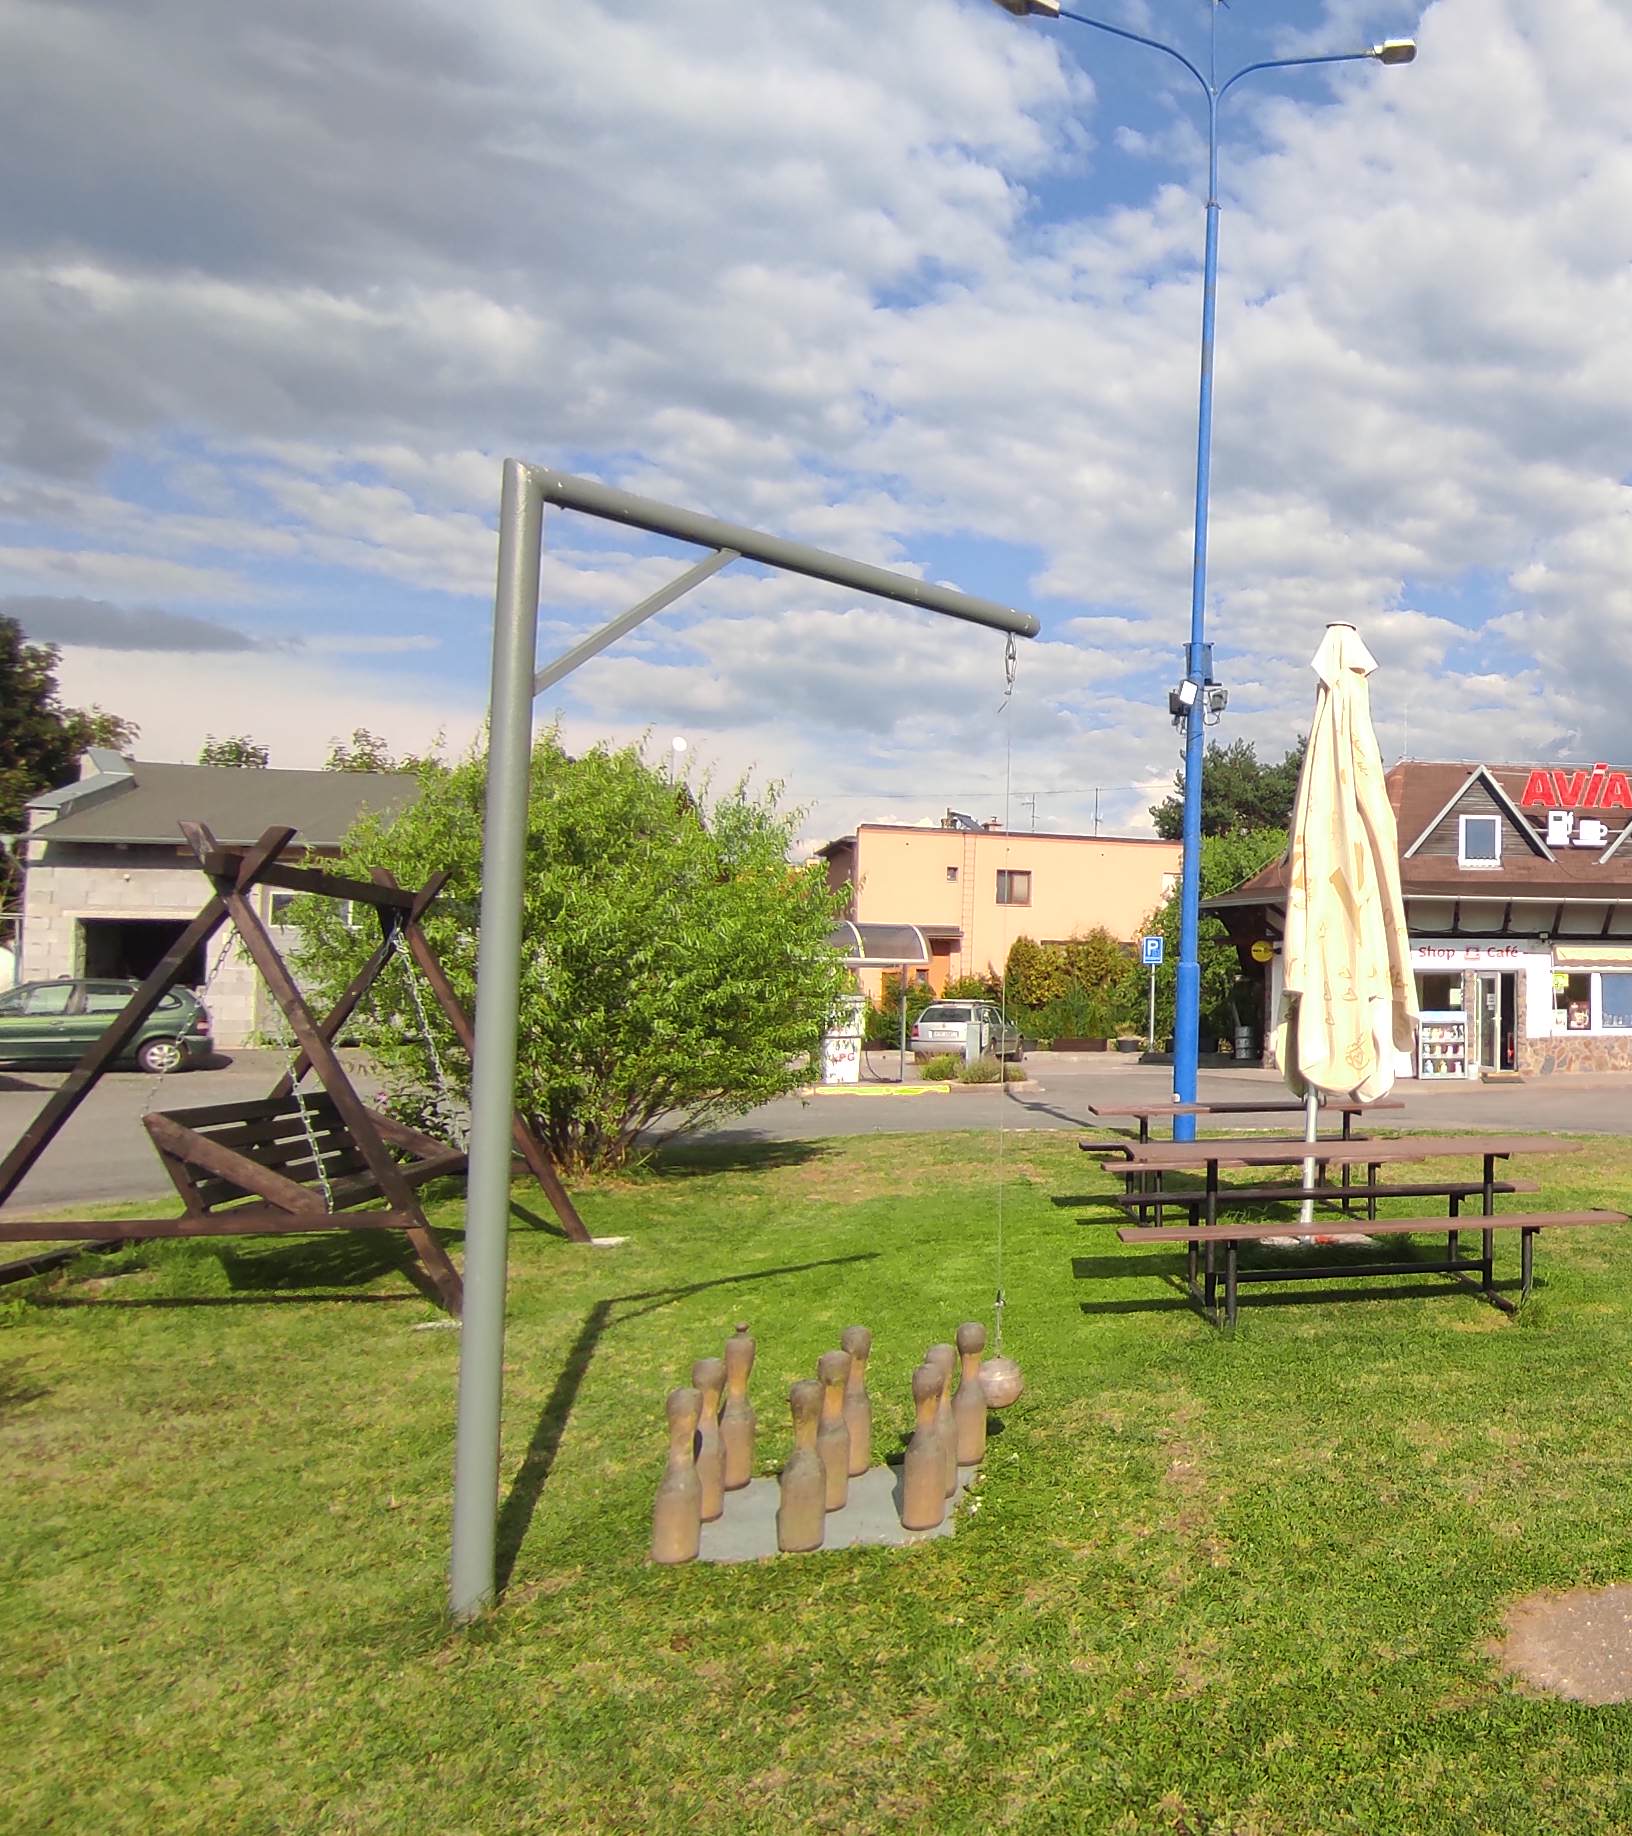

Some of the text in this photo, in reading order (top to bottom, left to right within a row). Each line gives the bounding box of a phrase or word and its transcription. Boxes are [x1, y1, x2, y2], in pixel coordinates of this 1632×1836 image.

[1147, 939, 1159, 956] P
[1418, 944, 1518, 960] Shop Café
